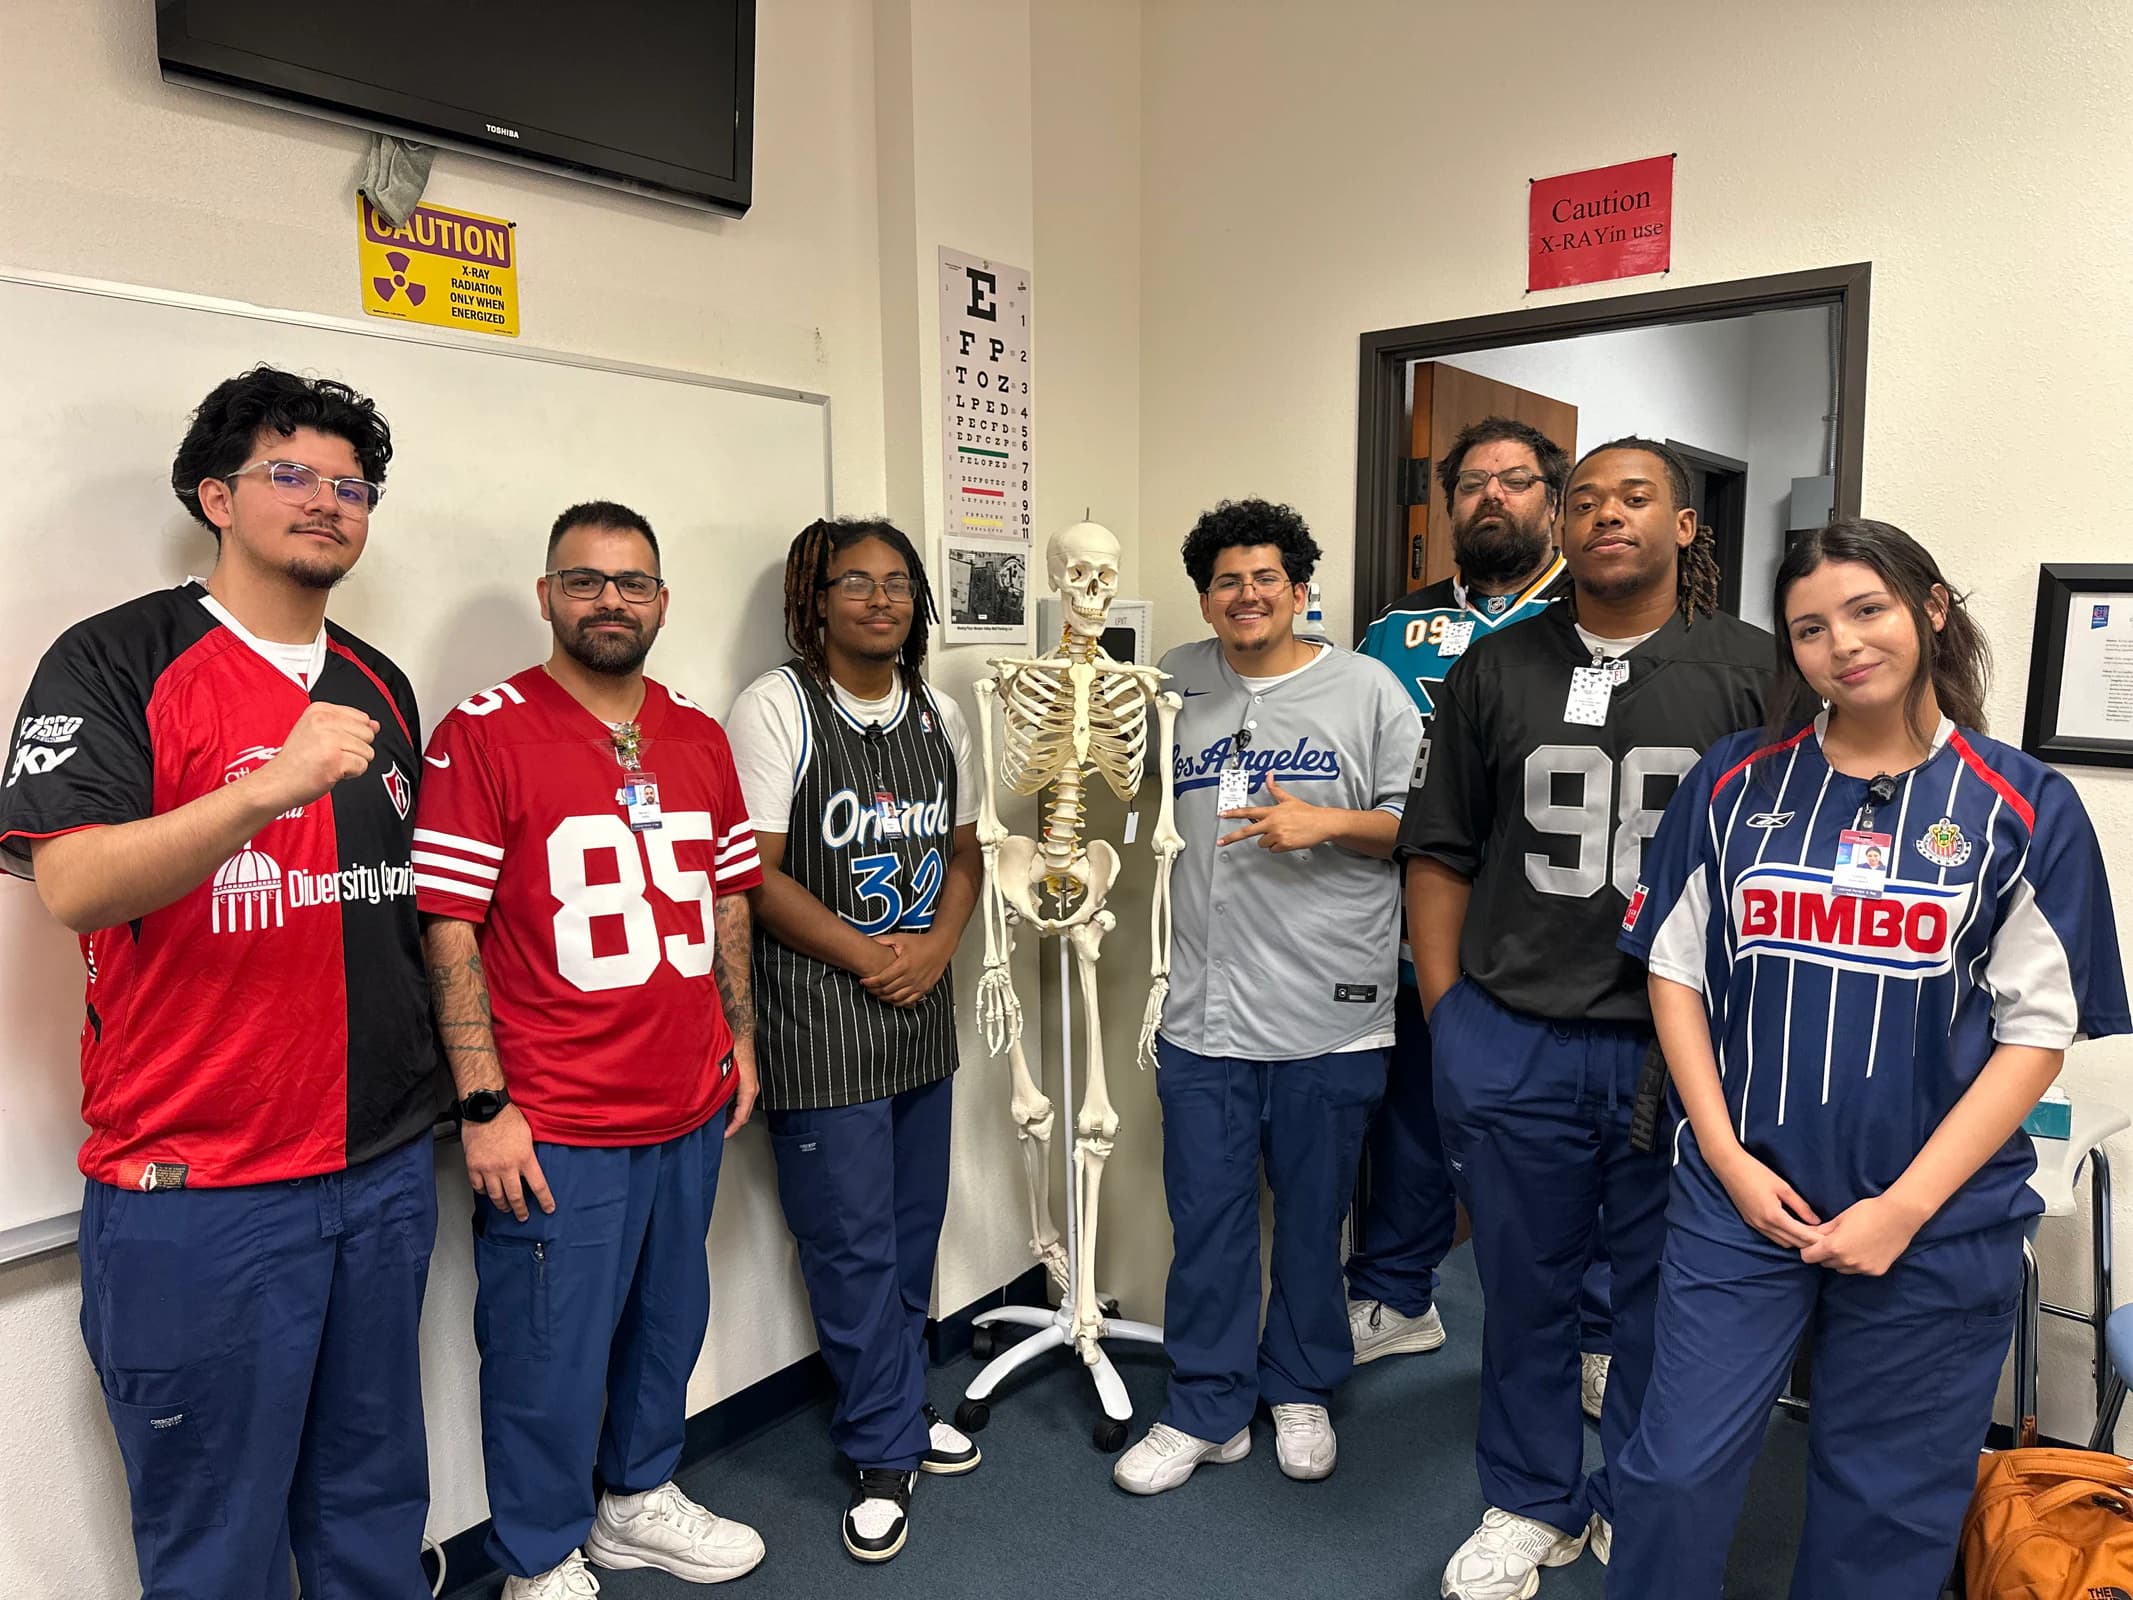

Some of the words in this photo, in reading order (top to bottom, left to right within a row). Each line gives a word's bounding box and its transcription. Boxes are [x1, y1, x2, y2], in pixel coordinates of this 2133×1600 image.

[485, 123, 519, 139] TOSHIBA
[1552, 190, 1650, 223] Caution
[371, 209, 505, 261] CAUTION
[1633, 222, 1664, 240] use
[462, 265, 490, 280] X-RAY
[451, 278, 502, 296] RADIATION
[450, 292, 475, 306] ONLY
[475, 297, 505, 311] WHEN
[966, 266, 997, 322] E
[1020, 314, 1026, 327] 1
[451, 307, 505, 325] ENERGIZED
[1020, 350, 1027, 363] 2
[1021, 382, 1028, 394] 3
[1021, 407, 1028, 419] 4
[1021, 425, 1028, 438] 5
[1022, 440, 1028, 452] 6
[1022, 462, 1029, 474] 7
[1022, 480, 1028, 491] 8
[1022, 500, 1028, 511] 9
[1021, 513, 1030, 525] 10
[1022, 527, 1029, 539] 11
[1196, 737, 1340, 795] Angeles
[822, 779, 950, 848] Orndo
[288, 862, 380, 909] Diversity
[381, 860, 416, 902] Capit
[838, 848, 943, 937] 32
[546, 812, 715, 992] 85
[1741, 888, 1948, 954] BIMBO
[2087, 1587, 2111, 1598] THE
